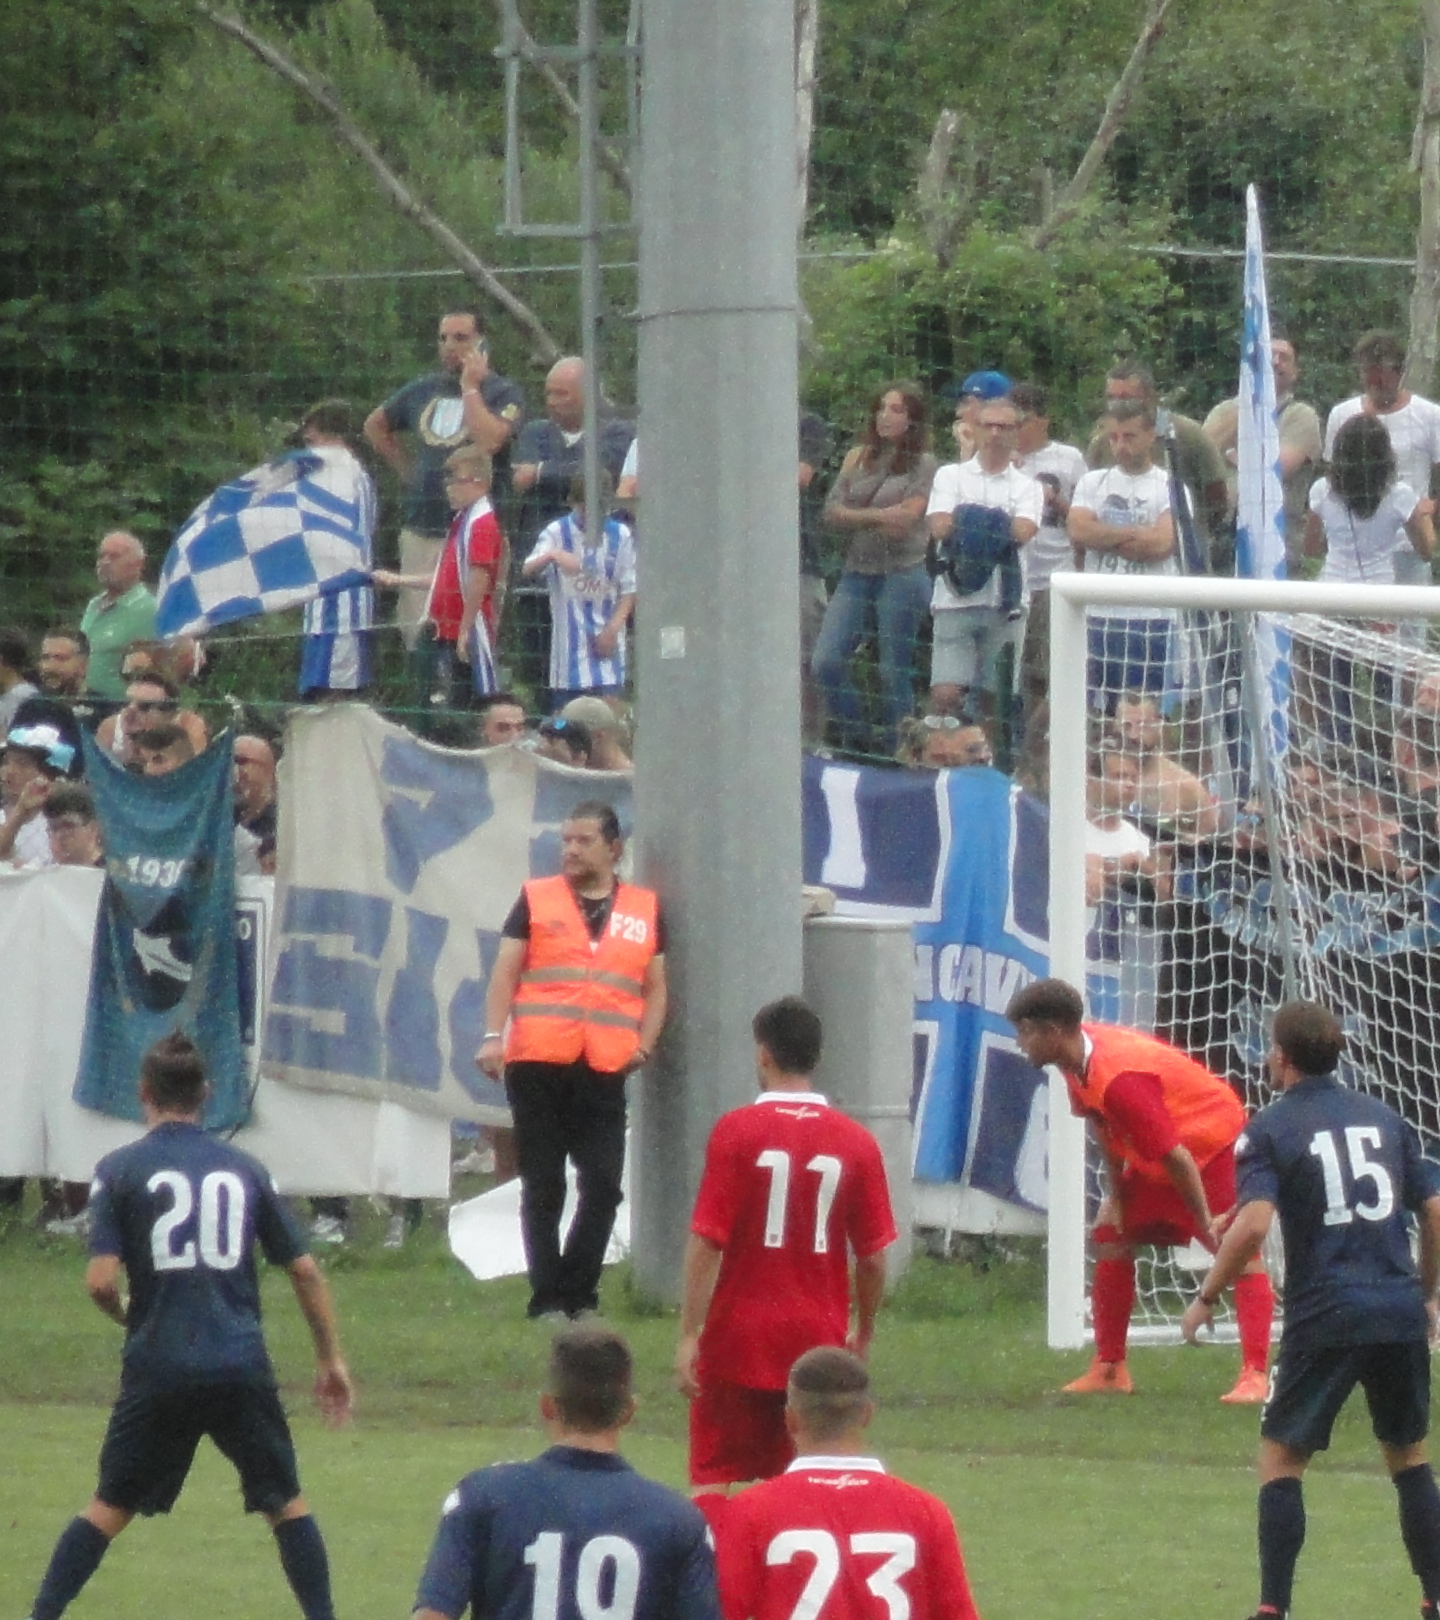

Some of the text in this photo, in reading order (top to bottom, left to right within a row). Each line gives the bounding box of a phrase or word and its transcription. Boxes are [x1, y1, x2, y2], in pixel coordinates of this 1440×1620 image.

[609, 911, 648, 945] F29
[146, 1170, 246, 1271] 20
[756, 1148, 843, 1255] 11
[1308, 1126, 1394, 1226] 15
